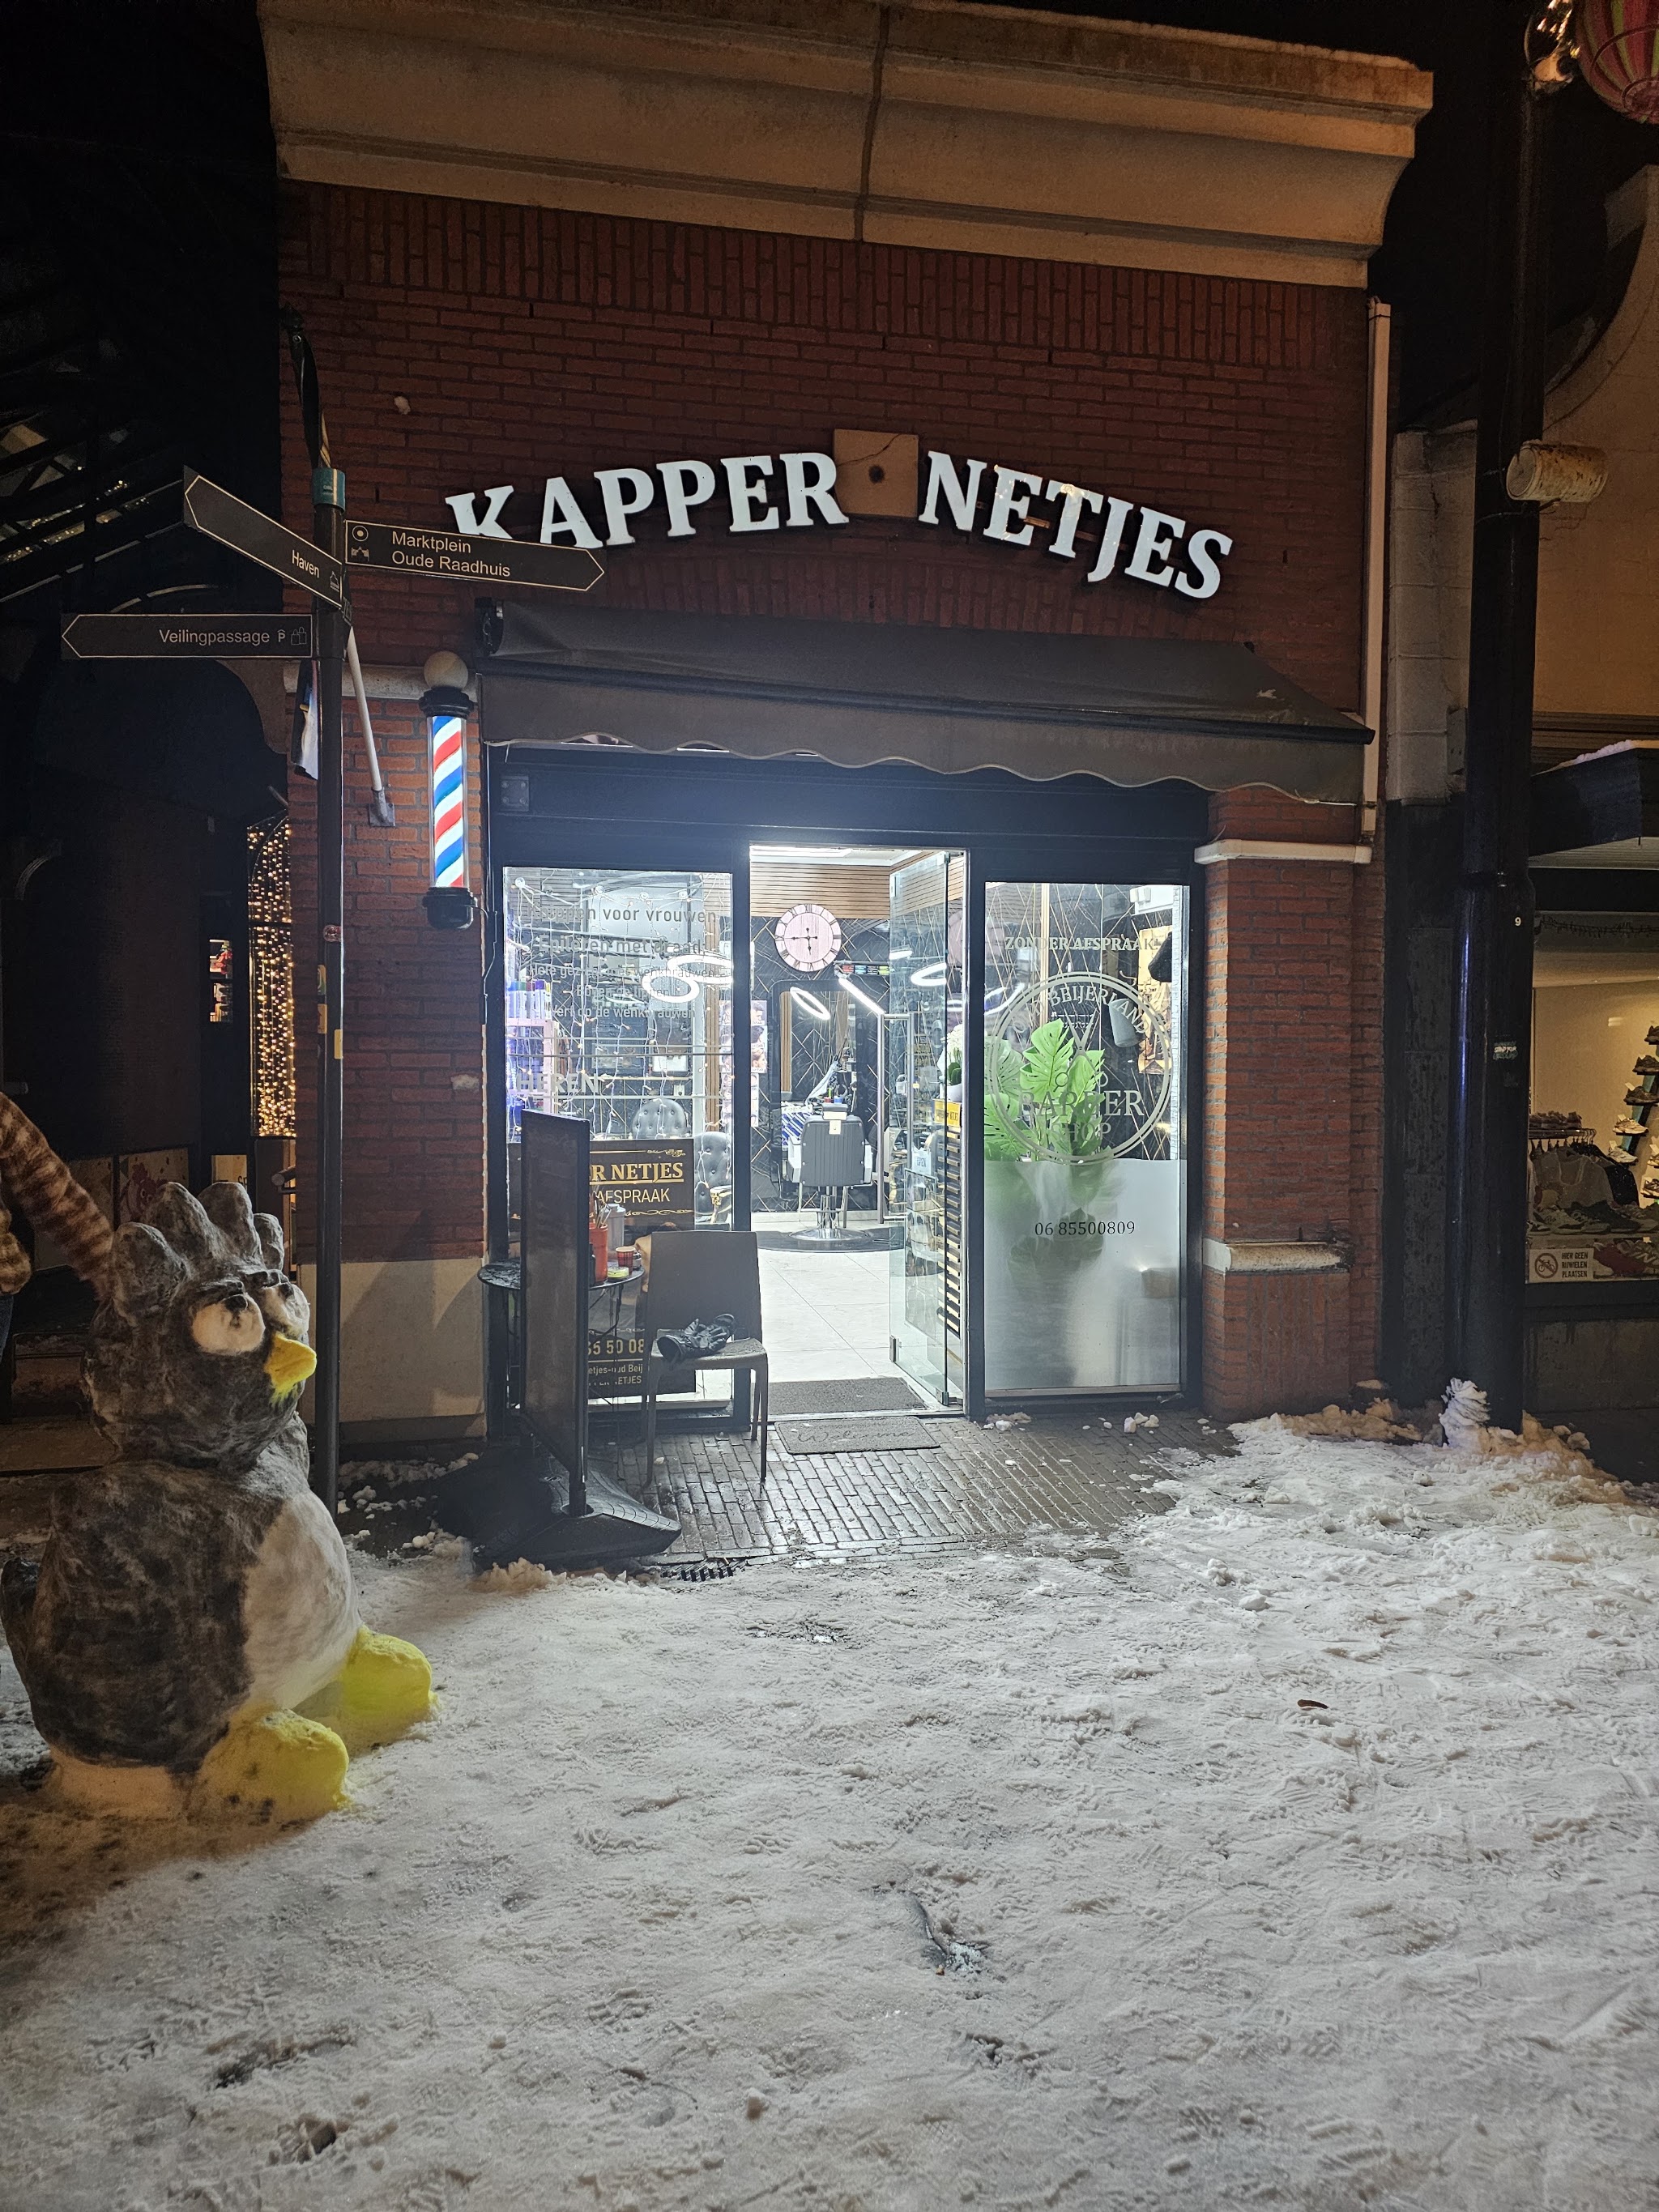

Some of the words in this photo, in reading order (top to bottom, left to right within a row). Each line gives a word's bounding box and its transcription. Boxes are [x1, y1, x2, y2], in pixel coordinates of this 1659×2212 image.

[446, 452, 849, 549] KAPPER
[919, 450, 1233, 599] NETJES
[392, 531, 471, 553] Marktplein
[292, 549, 320, 578] Haven
[392, 550, 433, 569] Oude
[439, 556, 510, 578] Raadhuis
[159, 629, 270, 646] Veilingpassage
[603, 907, 639, 921] voor
[646, 910, 716, 923] vrouwen
[1515, 916, 1521, 927] 9
[616, 940, 647, 953] met
[1005, 936, 1072, 951] ZONDER
[595, 1005, 610, 1017] de
[516, 1072, 599, 1093] HEREN
[1017, 1090, 1145, 1116] BARBER
[611, 1162, 684, 1183] NETJES
[598, 1187, 671, 1204] AFSPRAAK
[1034, 1222, 1054, 1235] 06
[1058, 1221, 1135, 1235] 85500809
